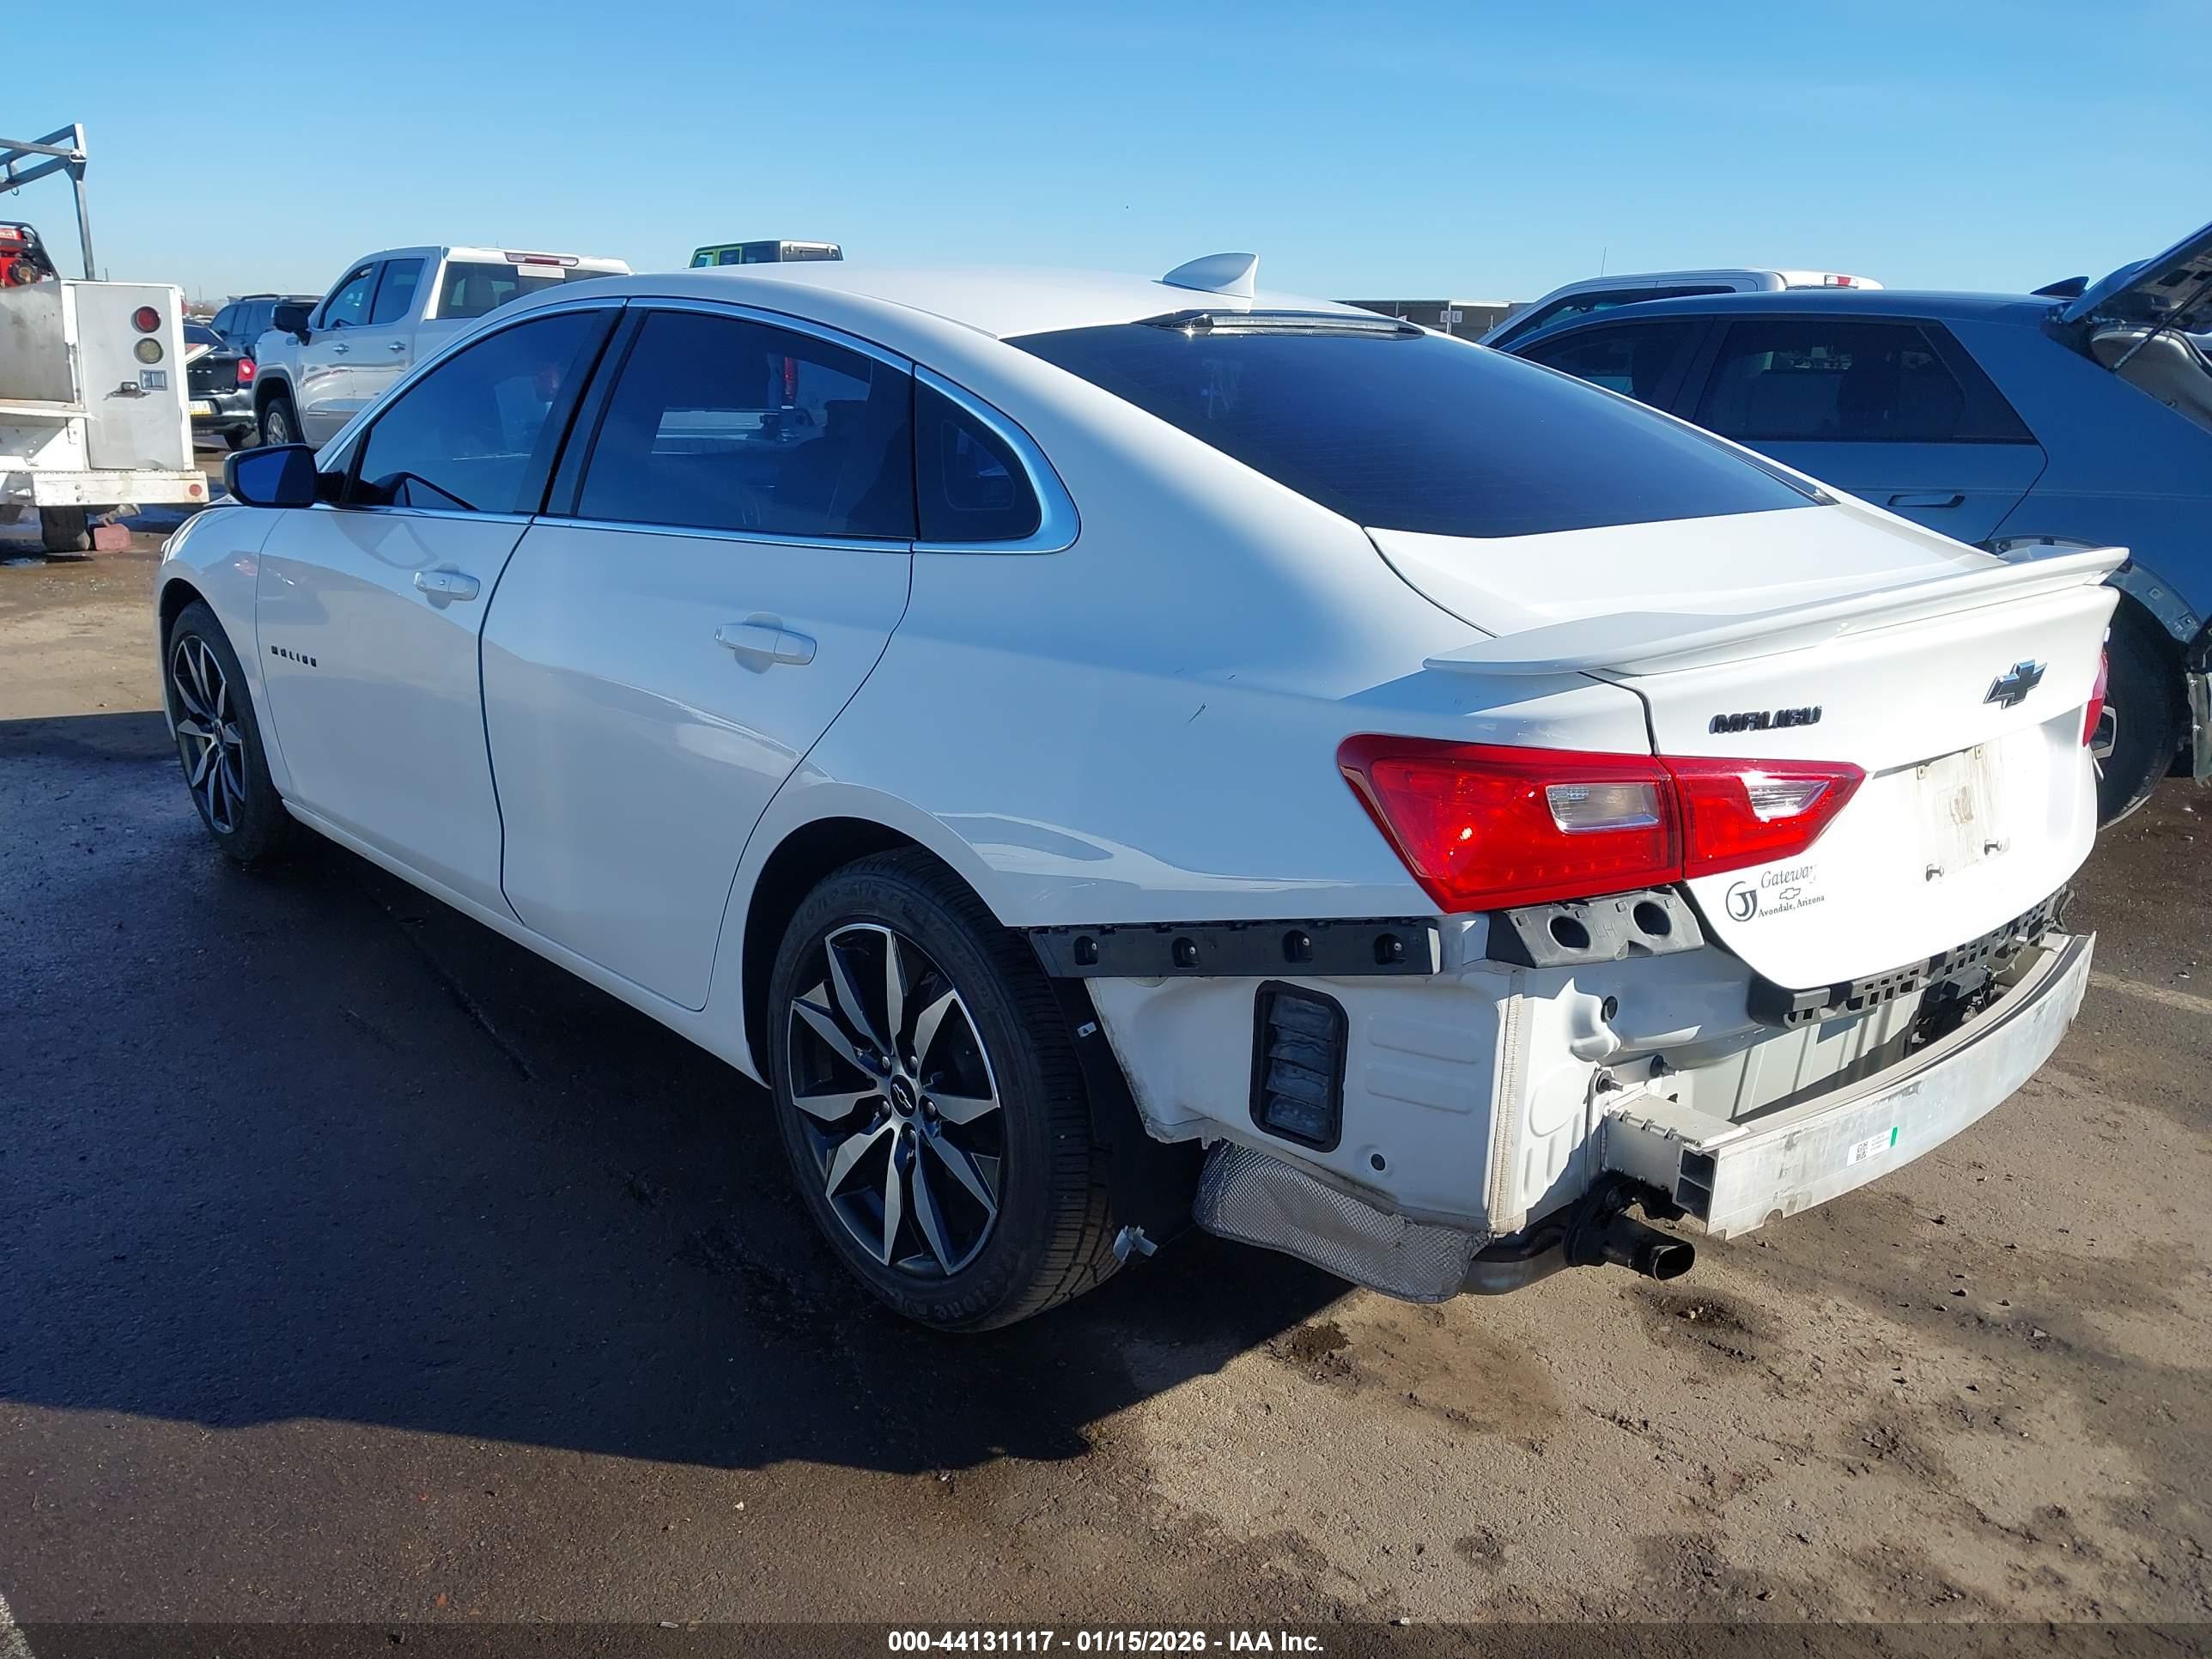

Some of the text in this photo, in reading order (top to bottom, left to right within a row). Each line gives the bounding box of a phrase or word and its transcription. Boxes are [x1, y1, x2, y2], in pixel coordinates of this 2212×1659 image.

[1708, 705, 1822, 734] MALIBU
[1758, 895, 1825, 919] Avondale, Arizona
